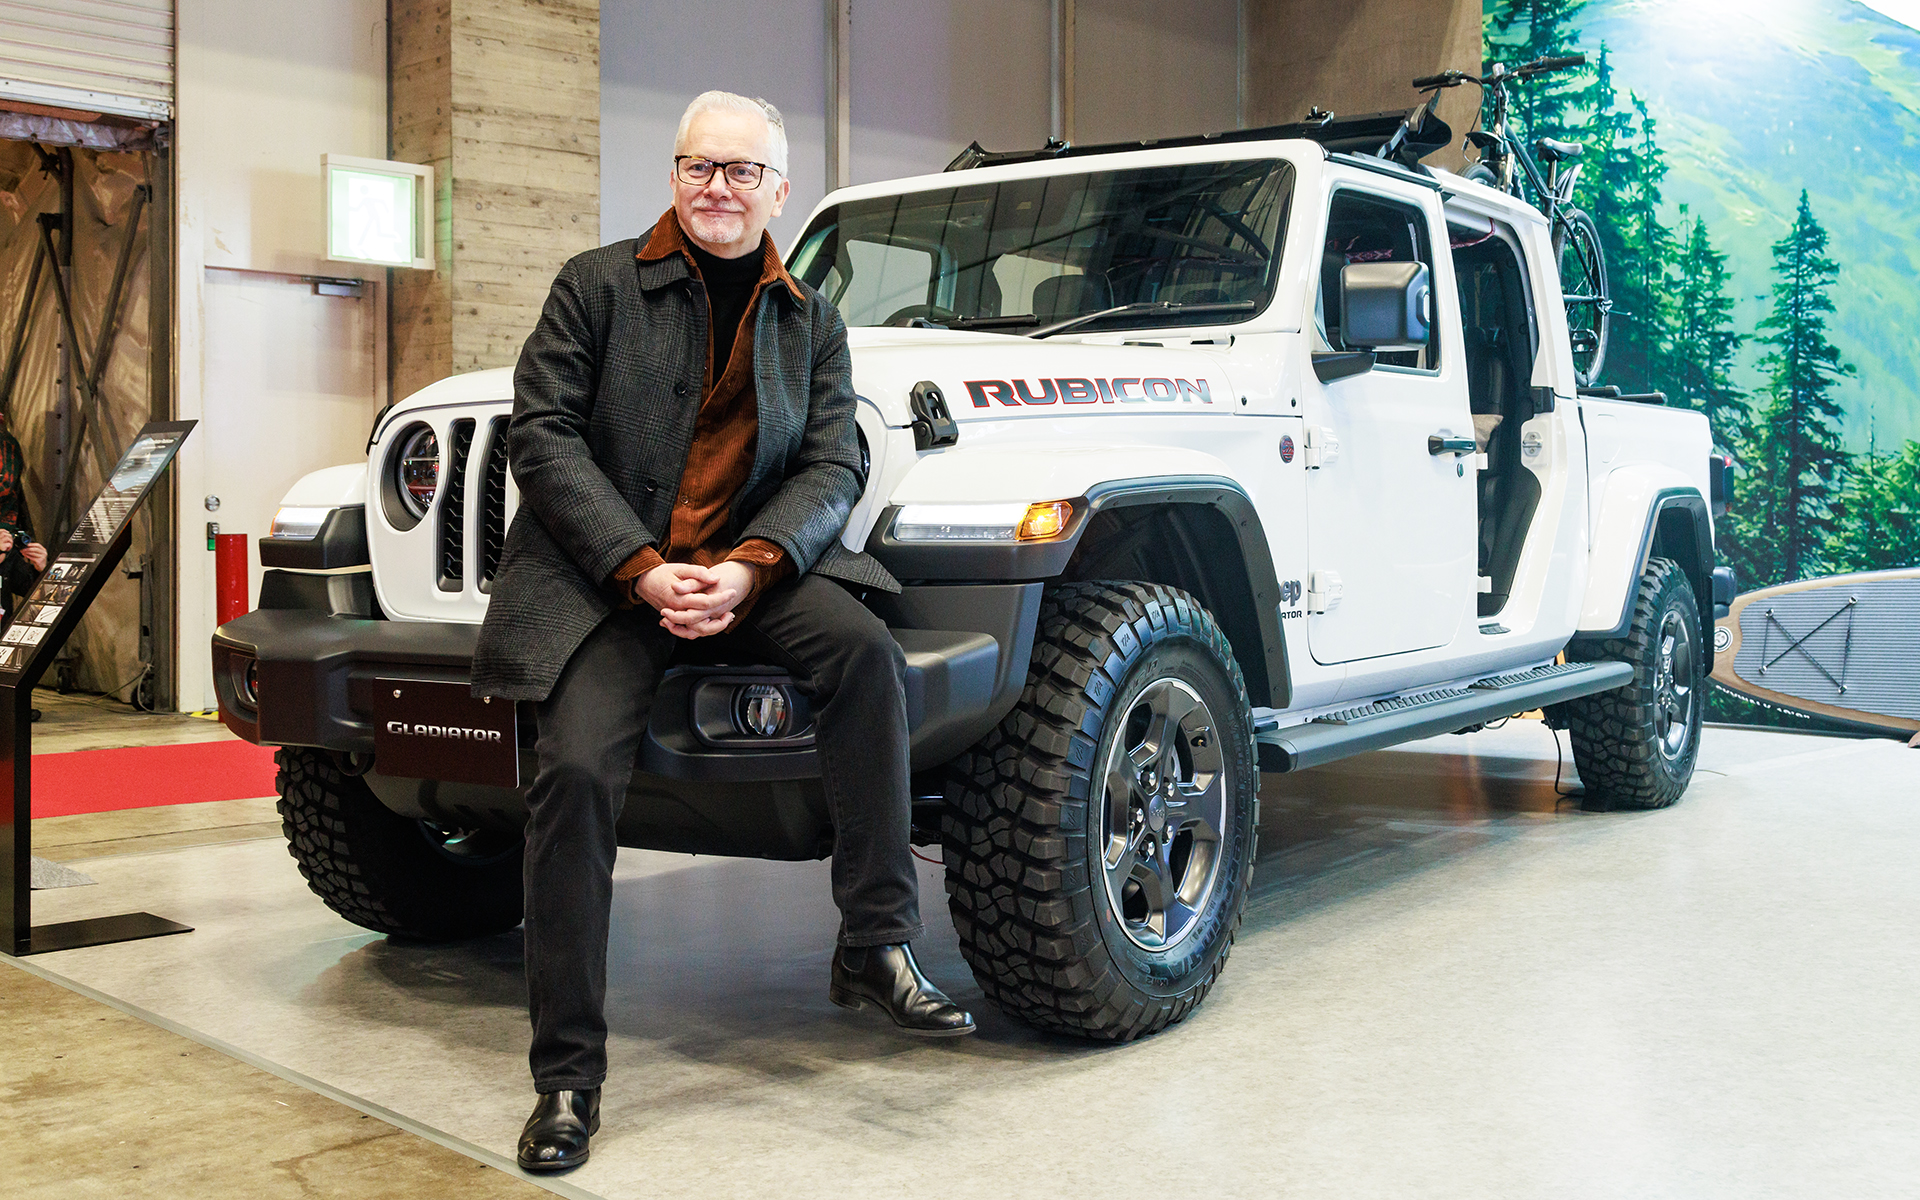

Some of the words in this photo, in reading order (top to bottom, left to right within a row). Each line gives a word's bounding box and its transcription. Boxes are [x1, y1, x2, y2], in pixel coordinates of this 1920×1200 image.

[963, 378, 1213, 408] RUBICON
[1281, 580, 1301, 606] ep
[386, 720, 502, 743] GLADIATOR
